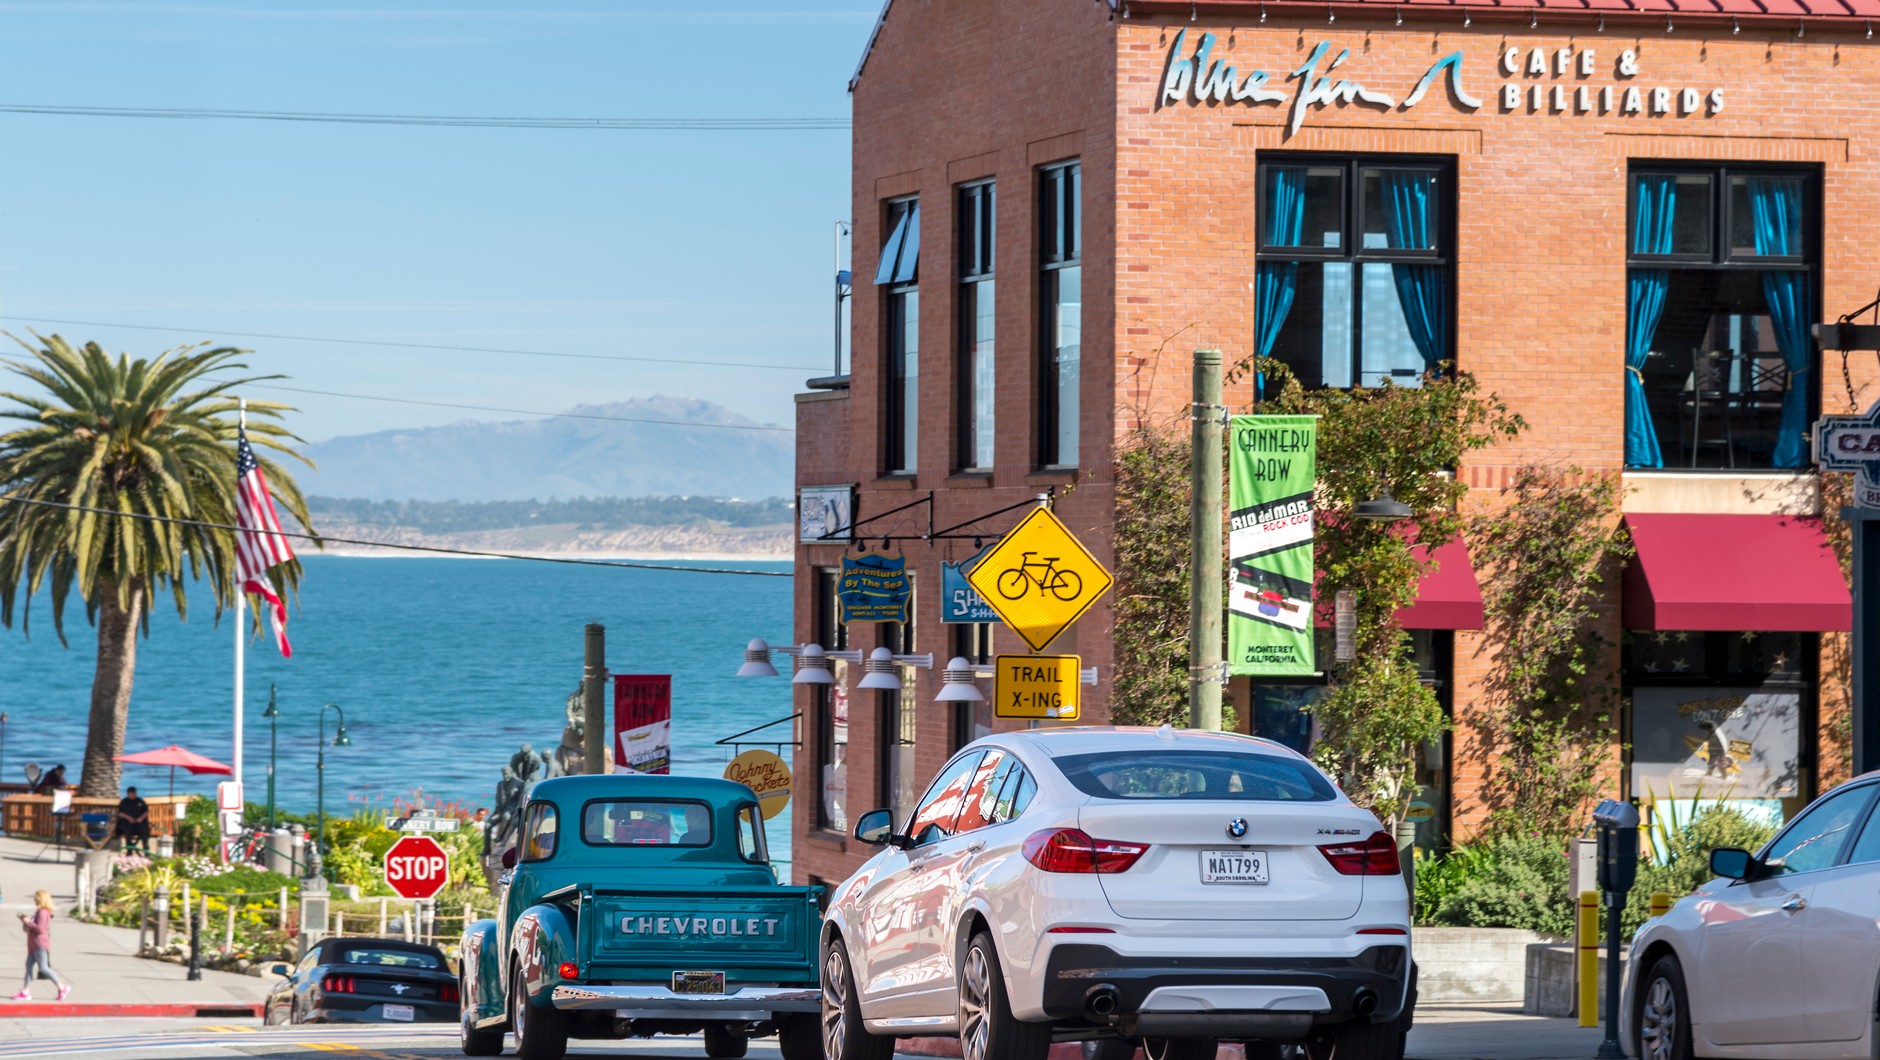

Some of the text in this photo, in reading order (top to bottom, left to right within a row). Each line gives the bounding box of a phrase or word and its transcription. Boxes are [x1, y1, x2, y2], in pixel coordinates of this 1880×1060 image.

[1504, 47, 1639, 76] CAFE &
[1161, 26, 1395, 136] blue fin
[1504, 83, 1725, 114] BILLIARDS
[1238, 429, 1309, 452] CANNERY
[1254, 458, 1291, 481] ROW
[1231, 512, 1257, 531] RIO
[1273, 500, 1309, 520] MAR
[1263, 520, 1289, 533] ROCK
[1290, 513, 1309, 526] COD
[844, 567, 903, 578] Adventures
[845, 578, 903, 589] By The Sea
[1245, 655, 1297, 663] CALIFORNIA
[1248, 645, 1295, 653] MONTEREY
[1011, 666, 1063, 682] TRAIL
[1012, 691, 1062, 708] X-ING
[730, 760, 782, 782] Johnny
[389, 856, 444, 880] STOP
[621, 917, 779, 936] CHEVROLET
